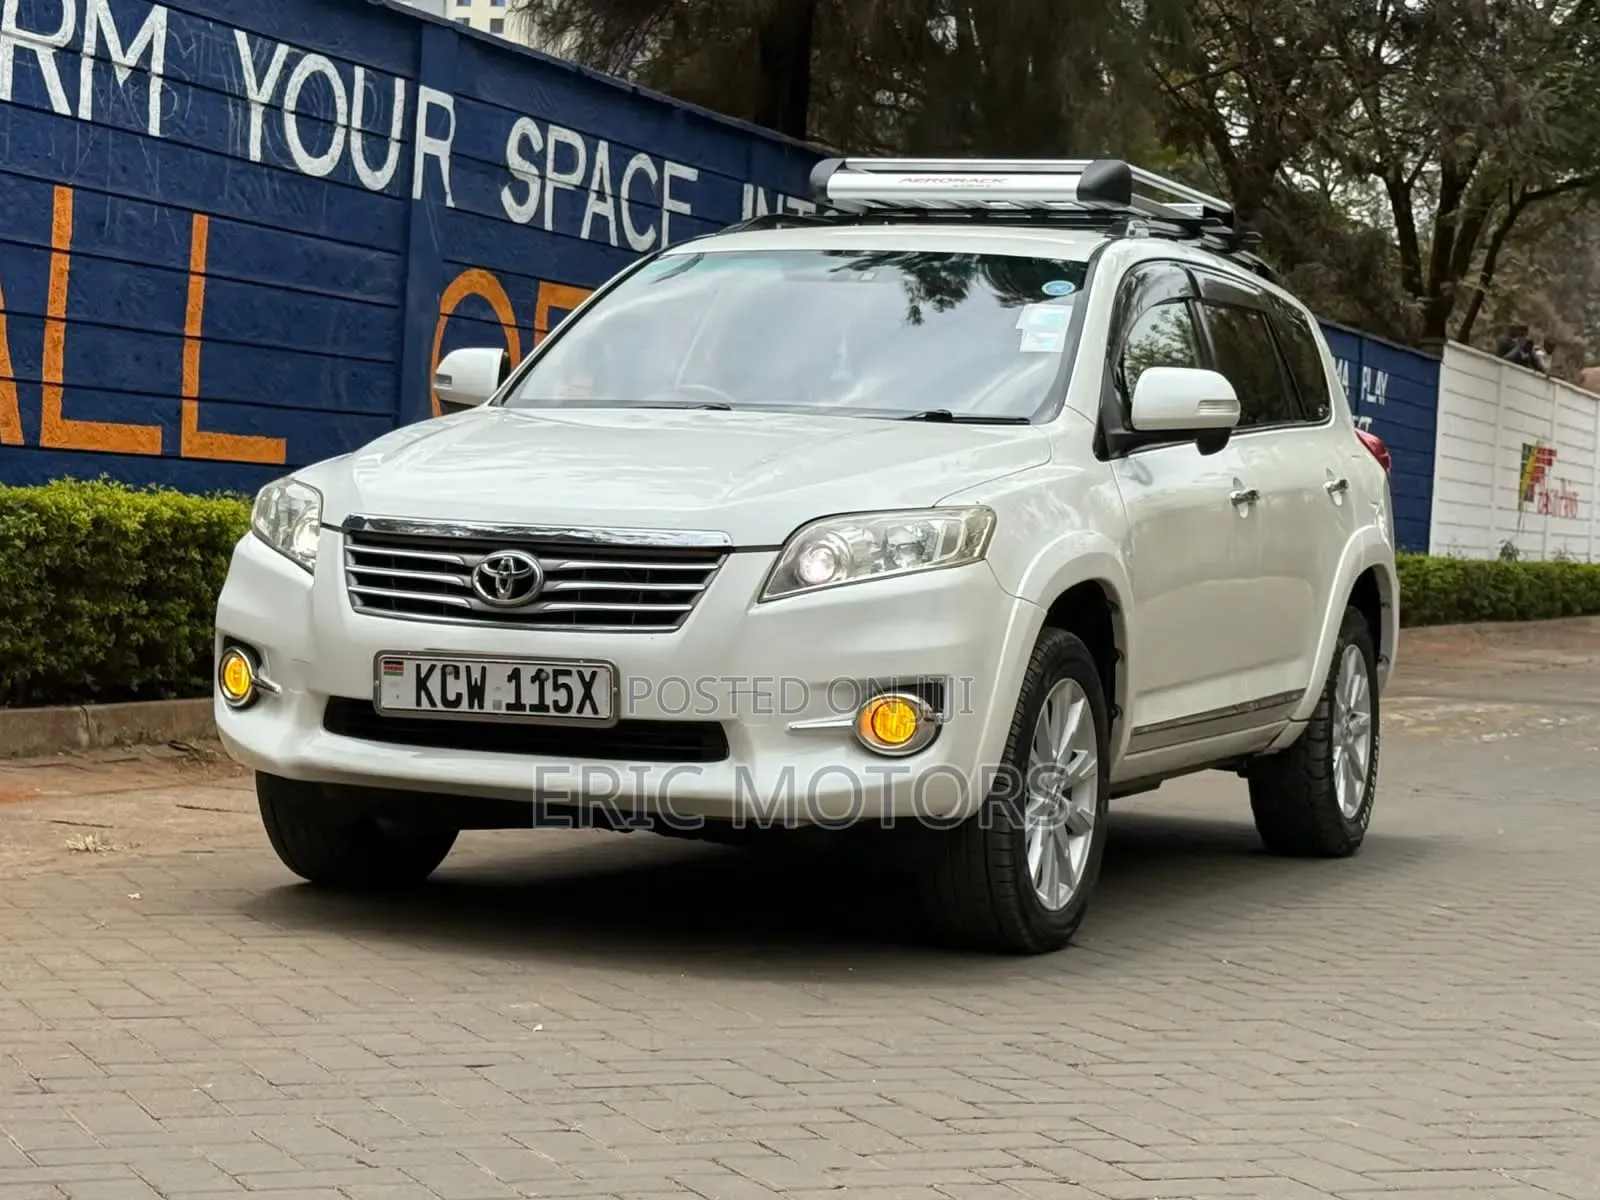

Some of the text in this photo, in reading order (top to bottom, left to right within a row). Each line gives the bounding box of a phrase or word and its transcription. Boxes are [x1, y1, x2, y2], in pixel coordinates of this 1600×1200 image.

[233, 29, 456, 208] YOUR
[1361, 365, 1389, 406] PLAY
[415, 663, 600, 715] KCW 115X
